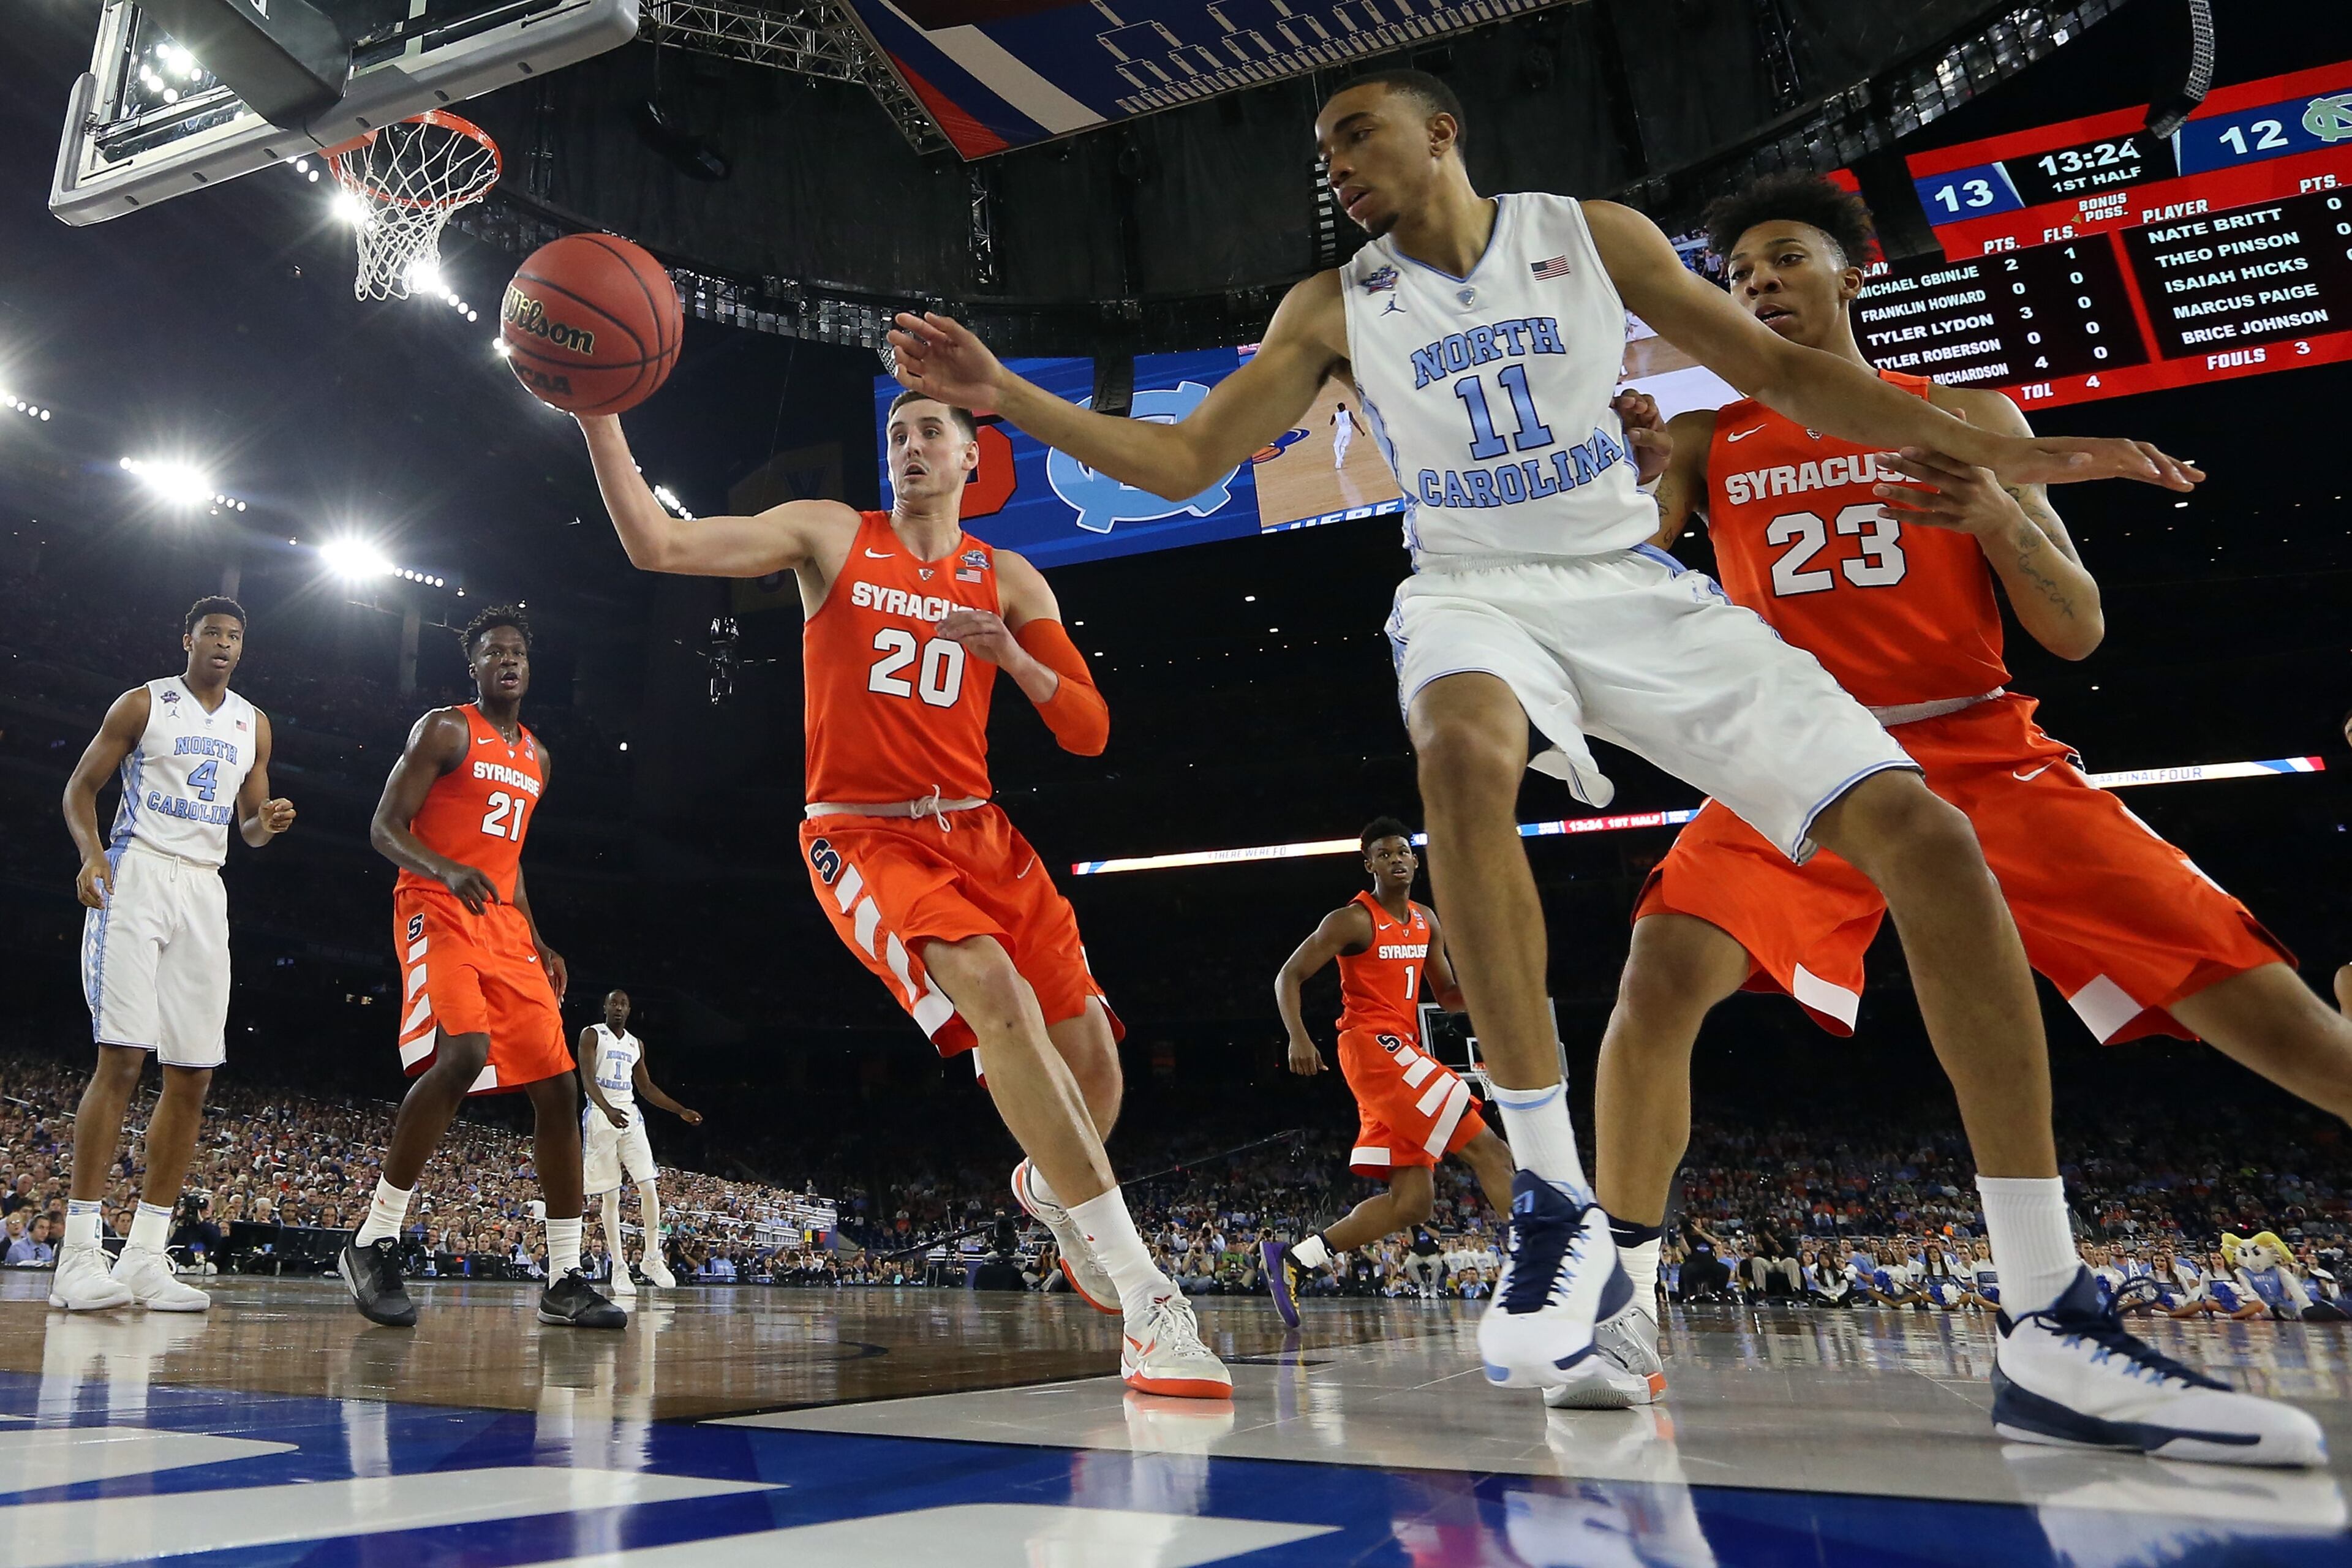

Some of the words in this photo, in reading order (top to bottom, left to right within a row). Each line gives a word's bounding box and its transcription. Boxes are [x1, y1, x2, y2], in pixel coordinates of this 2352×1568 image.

[2219, 119, 2289, 154] 12
[2038, 141, 2141, 176] 13:24
[1935, 179, 1994, 213] 13
[2052, 178, 2086, 193] 1ST
[2093, 166, 2141, 185] HALF
[2300, 175, 2342, 193] PTS.
[2079, 192, 2127, 211] BONUS
[2085, 205, 2129, 222] POSS.
[2142, 199, 2208, 223] PLAYER
[2327, 197, 2342, 210] 0
[2043, 225, 2079, 243] FLS.
[2148, 222, 2208, 244] NATE
[2213, 208, 2282, 232] BRITT
[2336, 222, 2351, 235] 0
[1983, 236, 2021, 255] PTS.
[2155, 248, 2212, 268] THEO
[2217, 232, 2300, 257] PINSON
[1856, 278, 1919, 300] MICHAEL
[1921, 266, 1980, 287] GBINIJE
[2004, 258, 2019, 271] 2
[2064, 247, 2076, 259] 1
[2165, 270, 2236, 293] ISAIAH
[2241, 257, 2309, 280] HICKS
[1861, 301, 1926, 323] FRANKLIN
[1929, 290, 1986, 310] HOWARD
[2012, 282, 2026, 294] 0
[2070, 272, 2083, 284] 0
[2173, 295, 2255, 319] MARCUS
[2258, 284, 2319, 304] PAIGE
[503, 286, 594, 356] Wilson
[1868, 326, 1928, 346] TYLER
[1931, 314, 1994, 335] LYDON
[2019, 307, 2034, 319] 3
[2078, 296, 2091, 308] 0
[2181, 325, 2237, 344] BRICE
[2241, 309, 2329, 334] JOHNSON
[1410, 317, 1566, 390] NORTH
[1874, 355, 1920, 370] TYLER
[1922, 338, 2001, 363] ROBERSON
[2027, 332, 2041, 344] 0
[2086, 322, 2100, 334] 0
[2207, 348, 2266, 370] FOULS
[2294, 341, 2310, 355] 3
[1933, 363, 2009, 385] RICHARDSON
[2035, 356, 2048, 368] 4
[2094, 347, 2108, 359] 0
[2021, 383, 2054, 400] TOL
[2086, 375, 2100, 388] 4
[1454, 364, 1555, 461] 11
[1418, 428, 1624, 508] CAROLINA
[1725, 452, 1922, 505] SYRACUS
[1766, 502, 1907, 598] 23
[868, 627, 965, 709] 20
[174, 736, 238, 765] NORTH
[187, 760, 218, 802] 4
[473, 761, 540, 798] SYRACUSE
[2118, 772, 2155, 783] FINAL
[2159, 767, 2203, 781] FOUR
[147, 791, 233, 825] CAROLIN
[481, 790, 526, 842] 21
[1608, 816, 1629, 828] 1ST
[1630, 815, 1660, 826] HALF
[810, 837, 842, 884] S
[407, 913, 424, 941] S
[1404, 965, 1414, 1000] 1
[614, 1061, 622, 1080] 1
